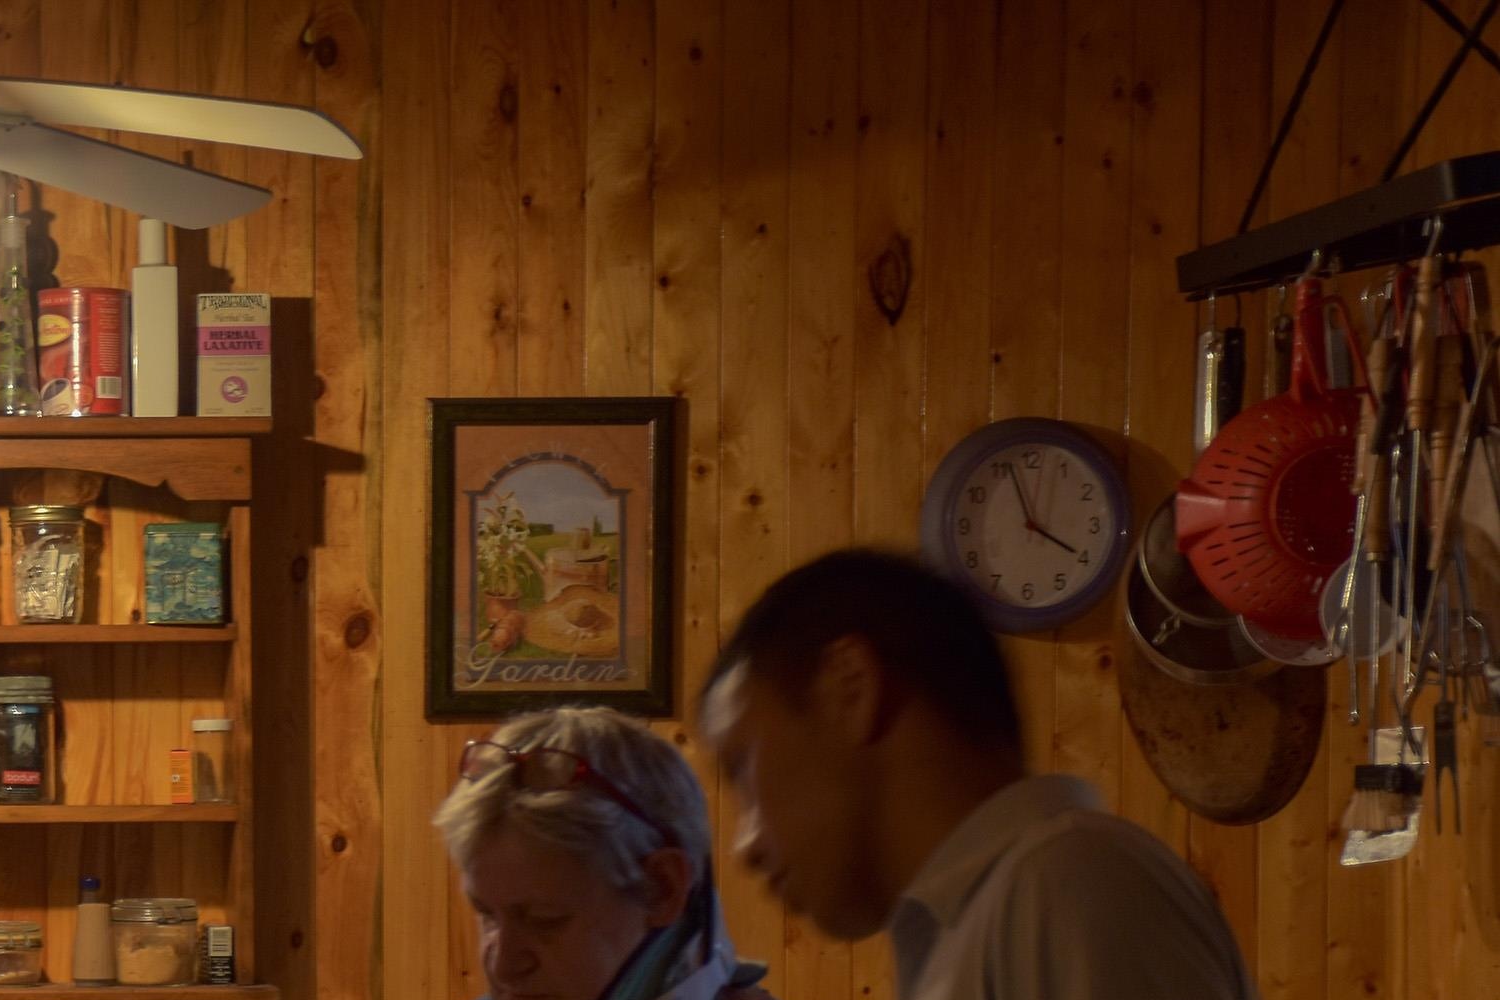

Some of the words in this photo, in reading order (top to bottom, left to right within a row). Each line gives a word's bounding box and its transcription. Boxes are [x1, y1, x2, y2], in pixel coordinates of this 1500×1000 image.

[209, 329, 257, 340] HERBAL
[203, 341, 264, 351] LAXATIVE
[1021, 451, 1041, 469] 12
[991, 462, 1009, 478] 11
[1060, 463, 1069, 479] 1
[968, 487, 987, 504] 10
[1081, 484, 1094, 501] 2
[959, 518, 971, 535] 9
[1089, 517, 1101, 534] 3
[966, 552, 979, 568] 8
[1078, 550, 1089, 566] 4
[991, 575, 1002, 592] 7
[1055, 574, 1066, 591] 5
[1022, 584, 1034, 600] 6
[454, 641, 638, 689] Garden
